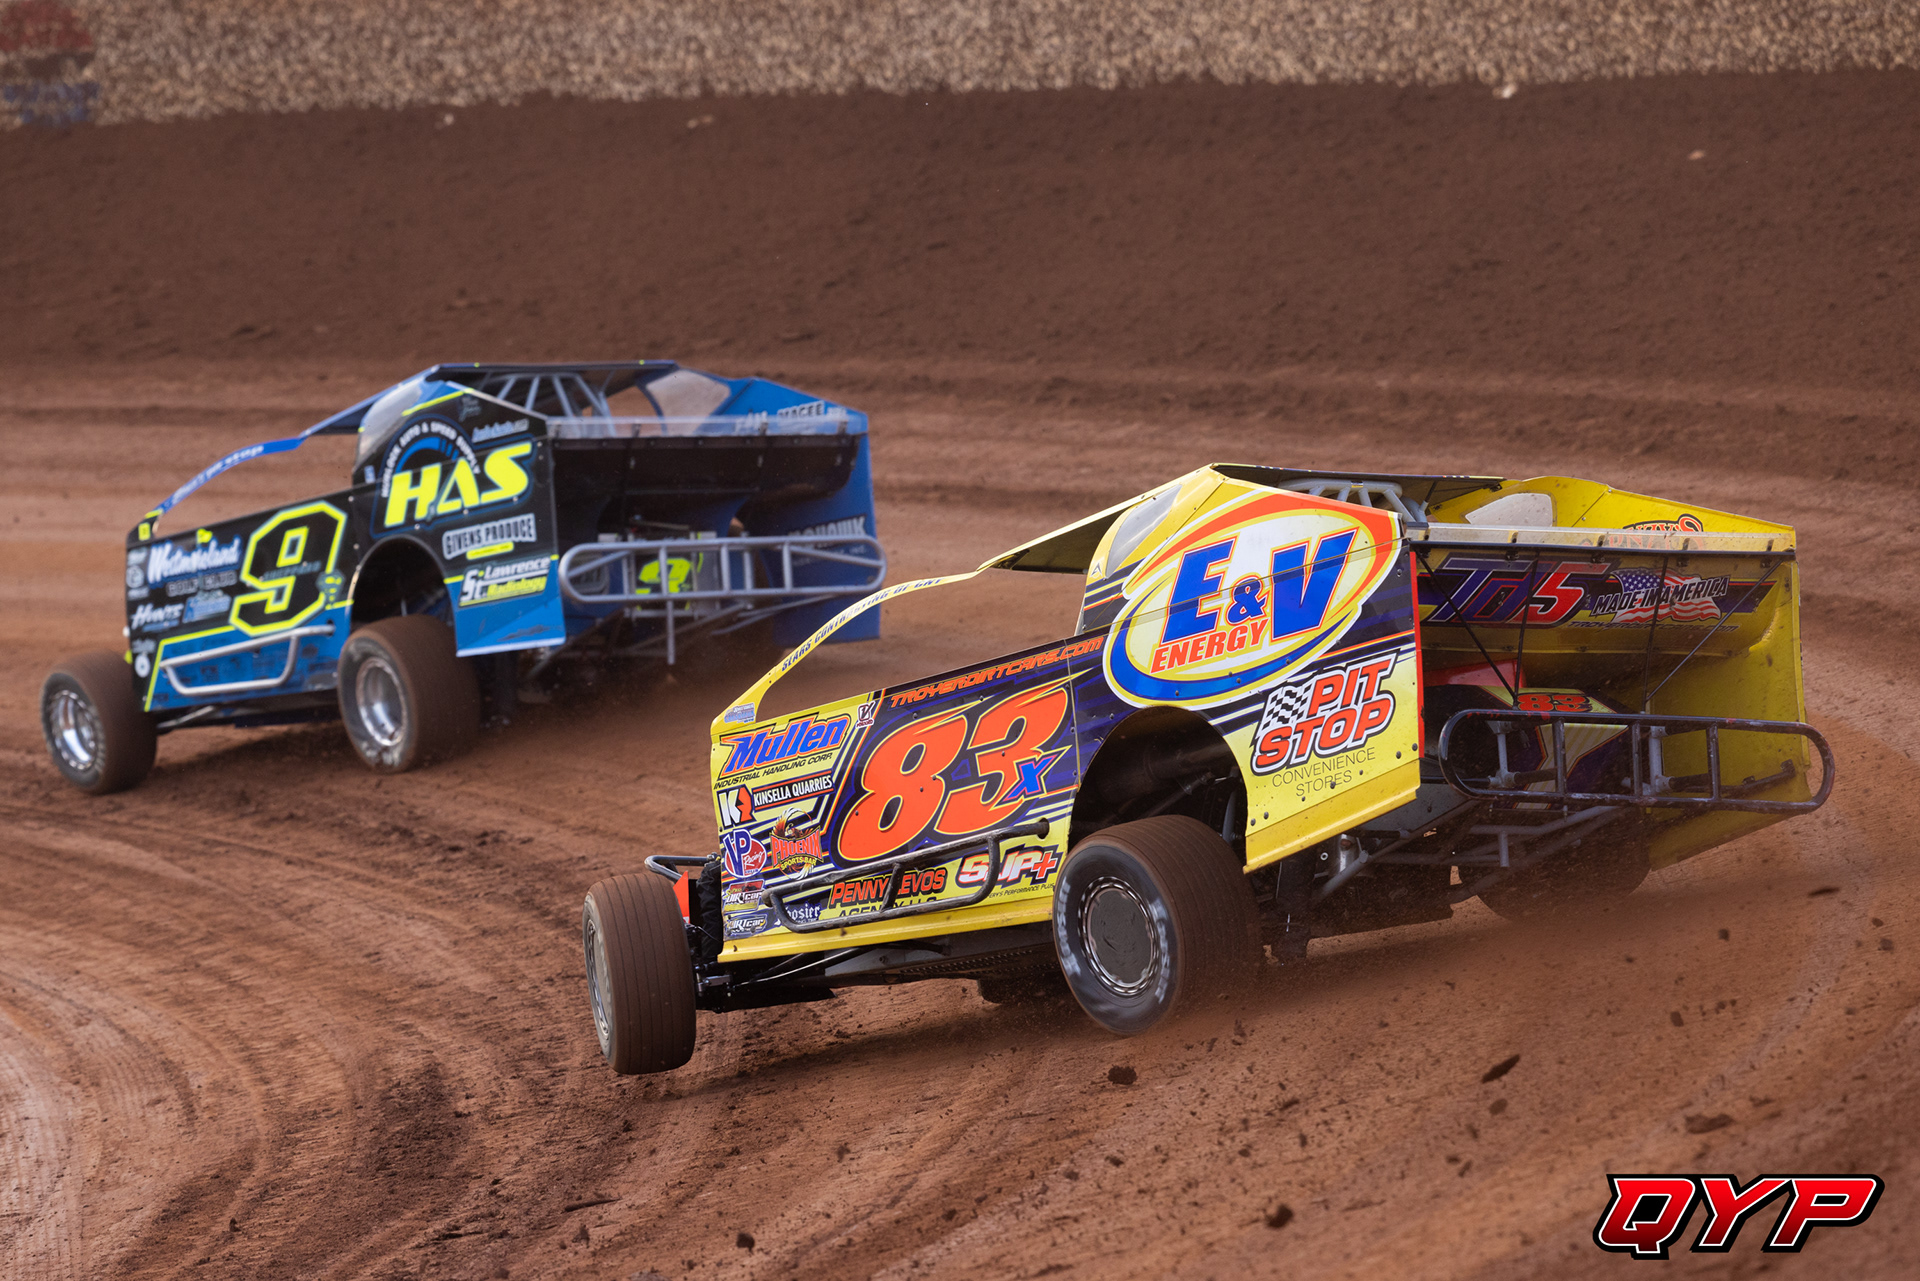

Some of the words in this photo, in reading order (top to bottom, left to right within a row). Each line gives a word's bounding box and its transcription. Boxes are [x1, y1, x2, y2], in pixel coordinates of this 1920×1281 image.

[384, 443, 532, 528] HAS
[485, 518, 533, 541] PRODUCE
[229, 500, 348, 637] 9
[1162, 527, 1359, 643] E&V
[1592, 590, 1639, 614] MADE
[1660, 576, 1730, 603] AMERICA
[1150, 619, 1268, 673] ENERGY
[1308, 654, 1396, 715] PIT
[721, 716, 849, 776] Mullen
[1256, 699, 1392, 766] STOP
[713, 772, 760, 790] INDUSTRIAL
[762, 759, 806, 777] HANDLING
[1272, 748, 1375, 787] CONVENIENCE
[1296, 769, 1352, 797] STORES
[753, 788, 791, 807] KINSELLA
[793, 774, 833, 796] QUARRIES
[723, 829, 752, 877] VP
[770, 829, 822, 866] PHOENIX
[831, 877, 890, 905] PENNY
[897, 870, 947, 895] EVOS
